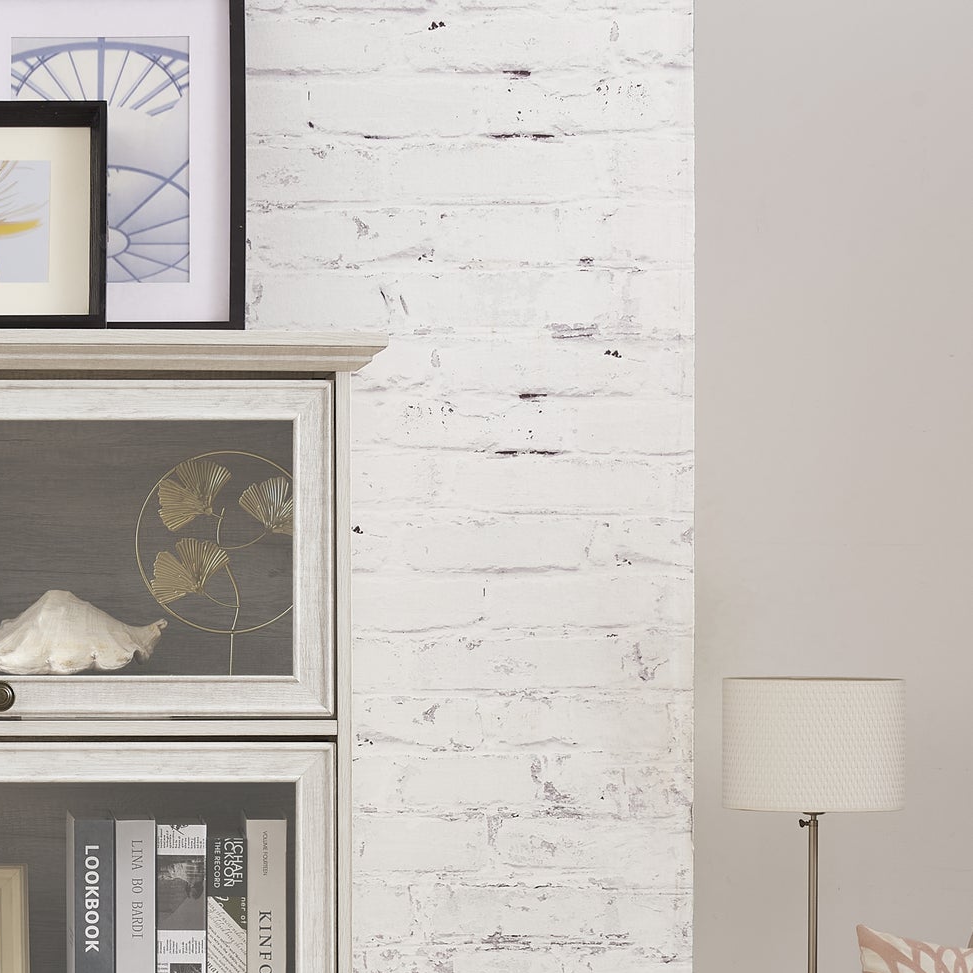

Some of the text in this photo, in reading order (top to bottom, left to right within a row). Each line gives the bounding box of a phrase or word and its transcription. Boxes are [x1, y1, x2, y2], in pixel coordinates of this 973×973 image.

[85, 845, 99, 952] LOOKBOOK
[132, 840, 143, 938] LINA BO BARDI
